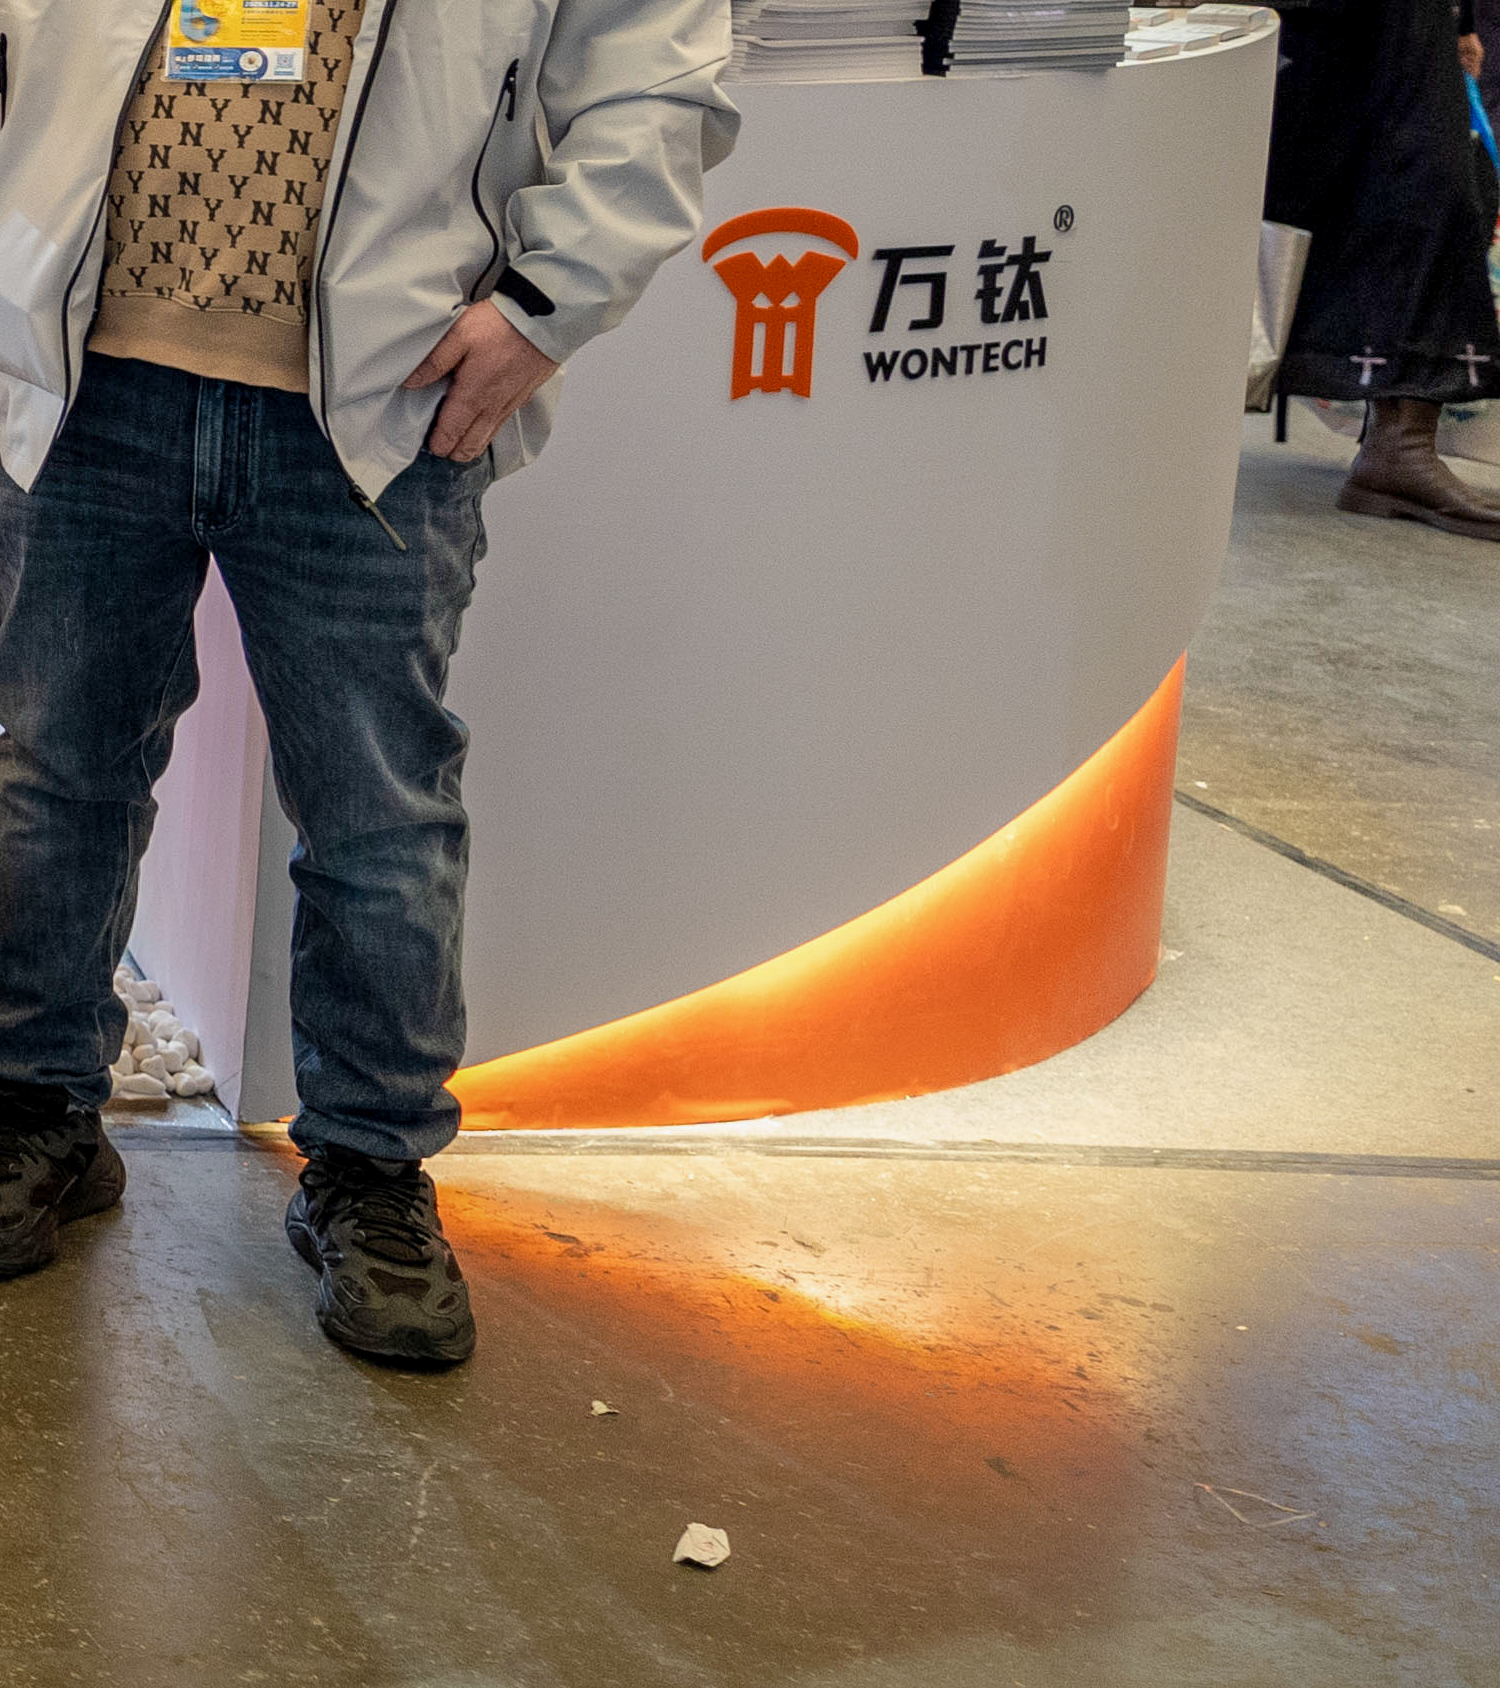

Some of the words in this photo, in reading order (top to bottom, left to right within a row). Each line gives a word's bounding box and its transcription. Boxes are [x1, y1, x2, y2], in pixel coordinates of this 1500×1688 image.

[329, 8, 345, 32] Y
[322, 58, 340, 81] Y
[292, 81, 316, 105] N
[152, 95, 176, 118] N
[211, 99, 230, 121] Y
[258, 100, 284, 125] N
[318, 108, 338, 131] Y
[179, 122, 204, 146] N
[233, 125, 253, 148] Y
[287, 129, 312, 155] N
[148, 145, 171, 168] N
[206, 149, 226, 172] Y
[254, 150, 279, 175] N
[313, 158, 331, 182] Y
[125, 170, 144, 194] Y
[177, 172, 201, 195] N
[229, 175, 249, 199] Y
[284, 180, 307, 205] N
[148, 195, 171, 218] N
[204, 198, 223, 221] Y
[250, 201, 276, 226] N
[129, 219, 145, 243] Y
[179, 220, 199, 244] N
[225, 225, 244, 247] Y
[278, 231, 299, 255] N
[150, 242, 173, 264] N
[200, 247, 219, 270] Y
[245, 251, 270, 275] N
[127, 266, 148, 288] Y
[220, 274, 240, 296] Y
[272, 280, 296, 306] N
[868, 236, 1052, 333] 万钛
[862, 336, 1048, 383] WONTECH
